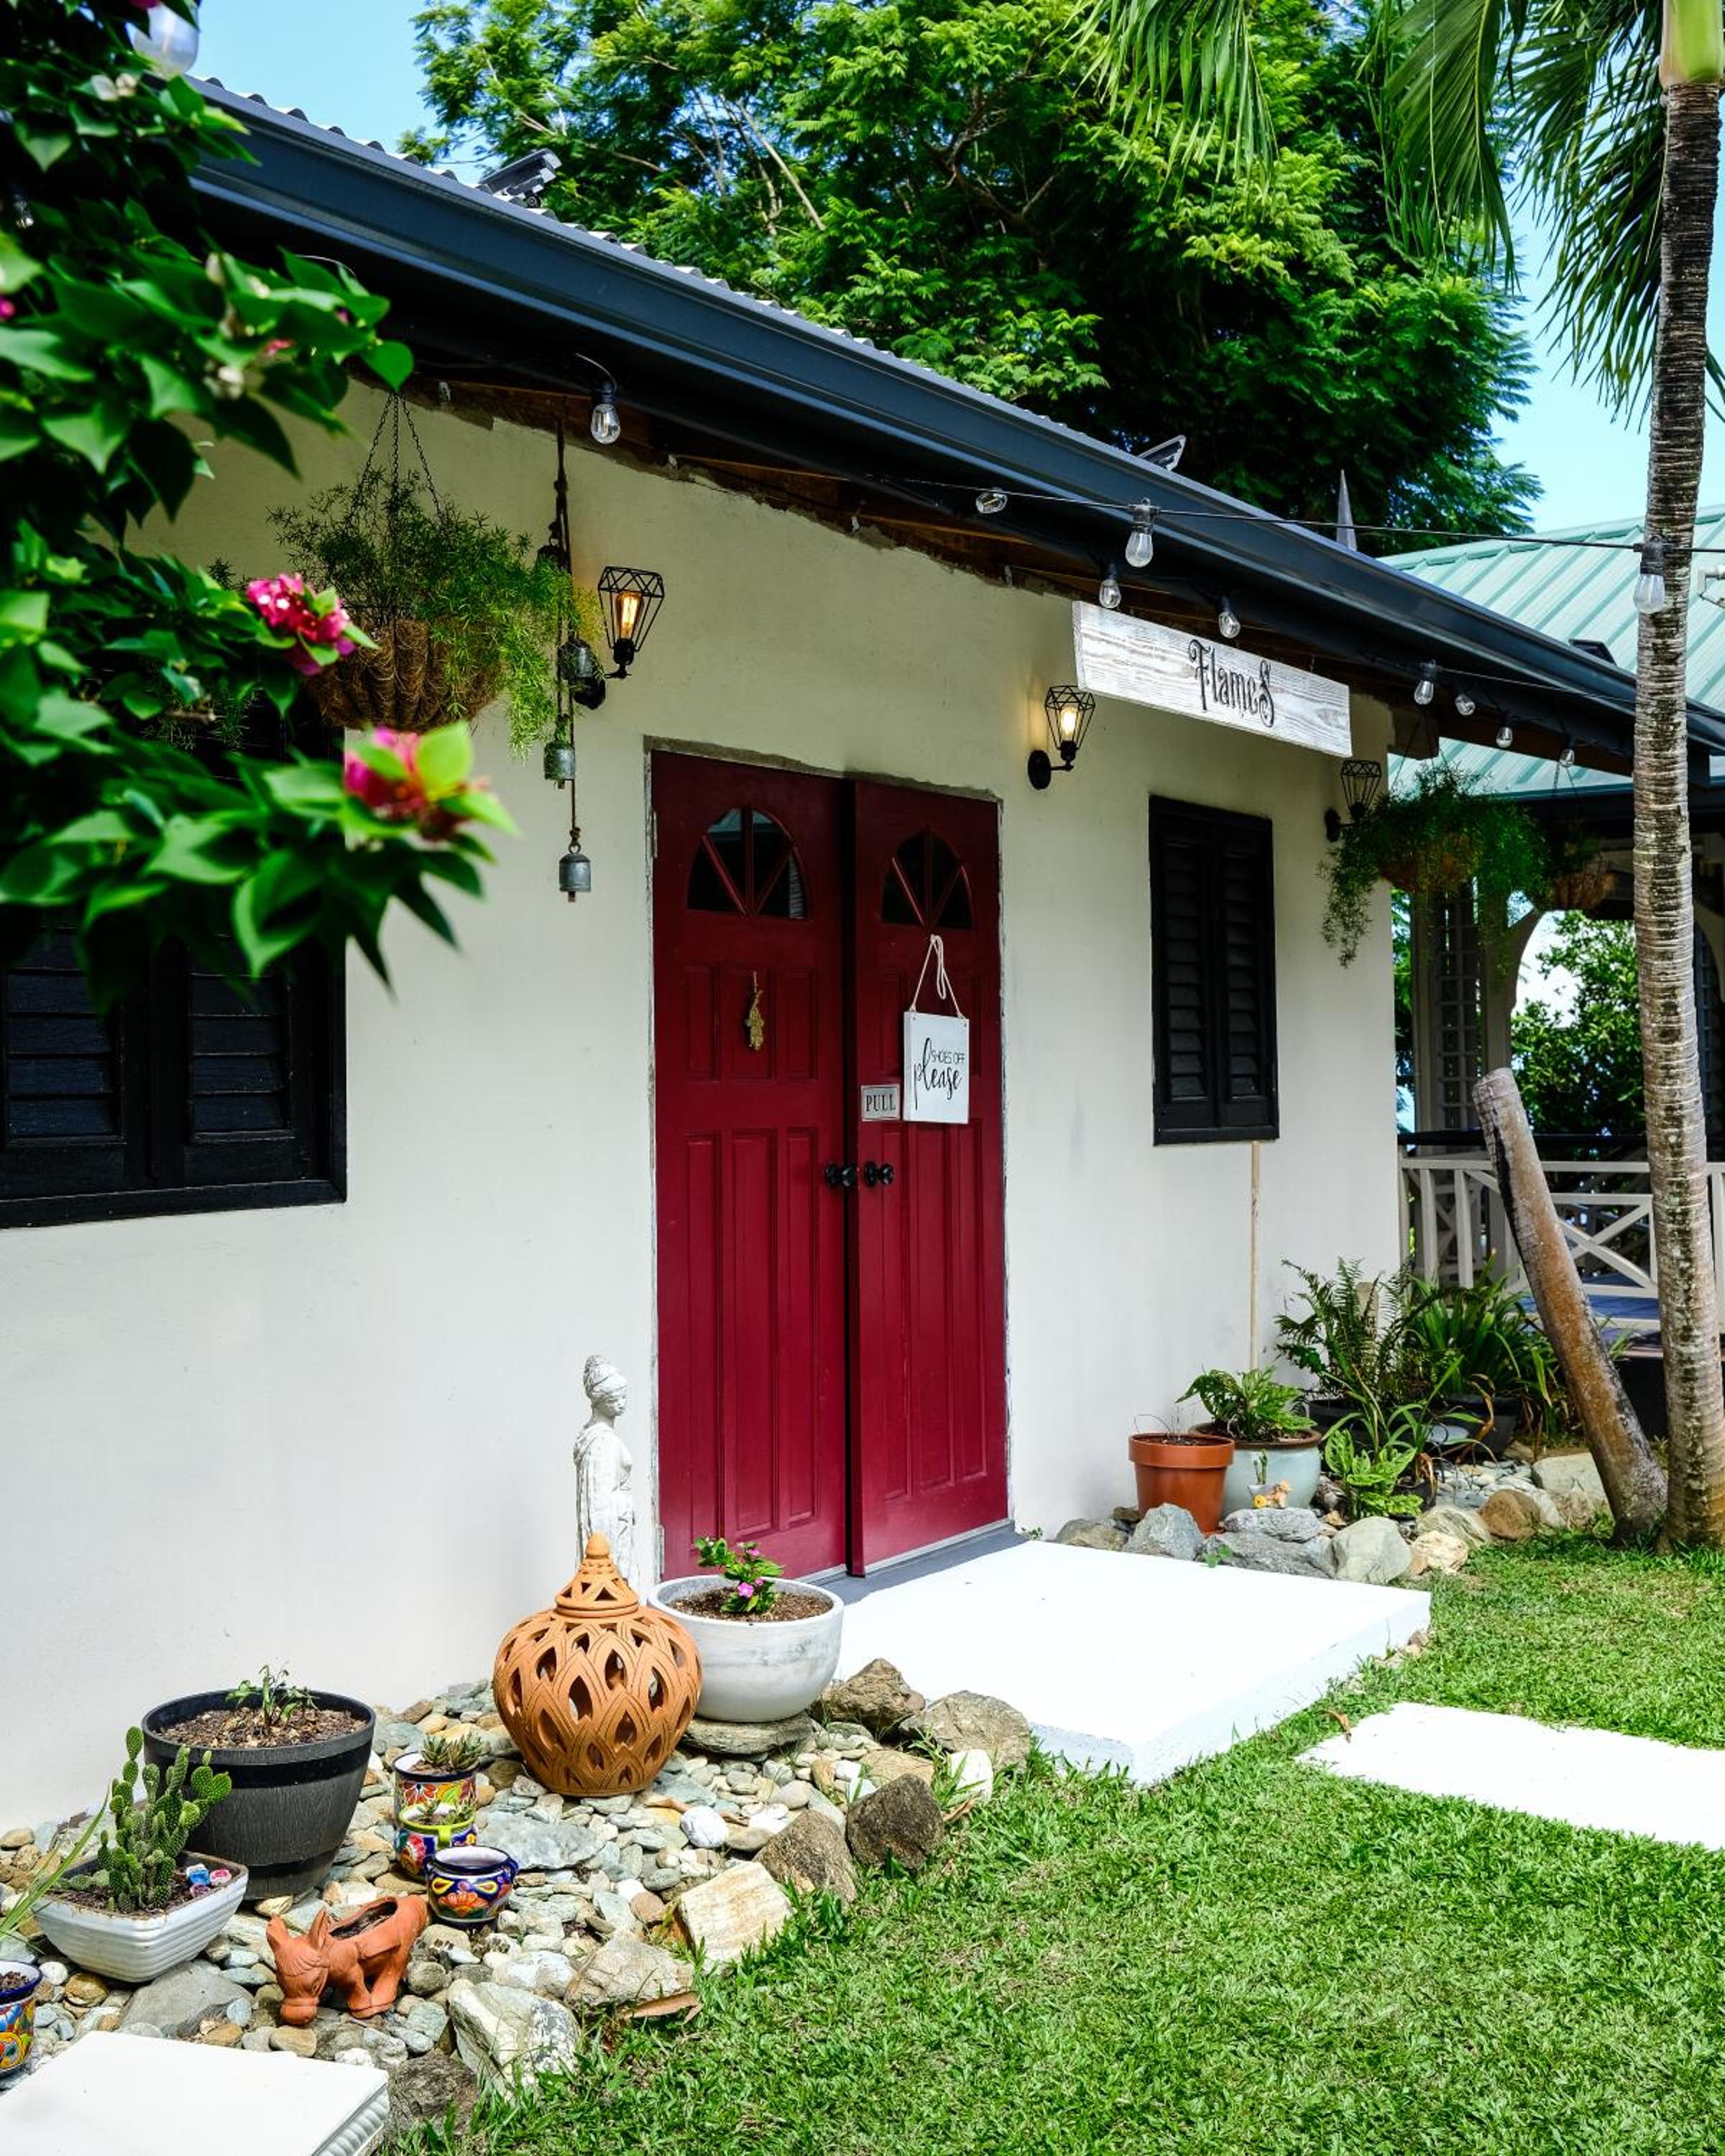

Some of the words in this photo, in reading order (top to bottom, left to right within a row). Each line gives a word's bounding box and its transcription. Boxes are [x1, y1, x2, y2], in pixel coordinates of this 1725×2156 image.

[931, 1049, 952, 1064] SHOES
[953, 1051, 965, 1065] OFF
[914, 1037, 962, 1110] please
[865, 1094, 896, 1112] PULL
